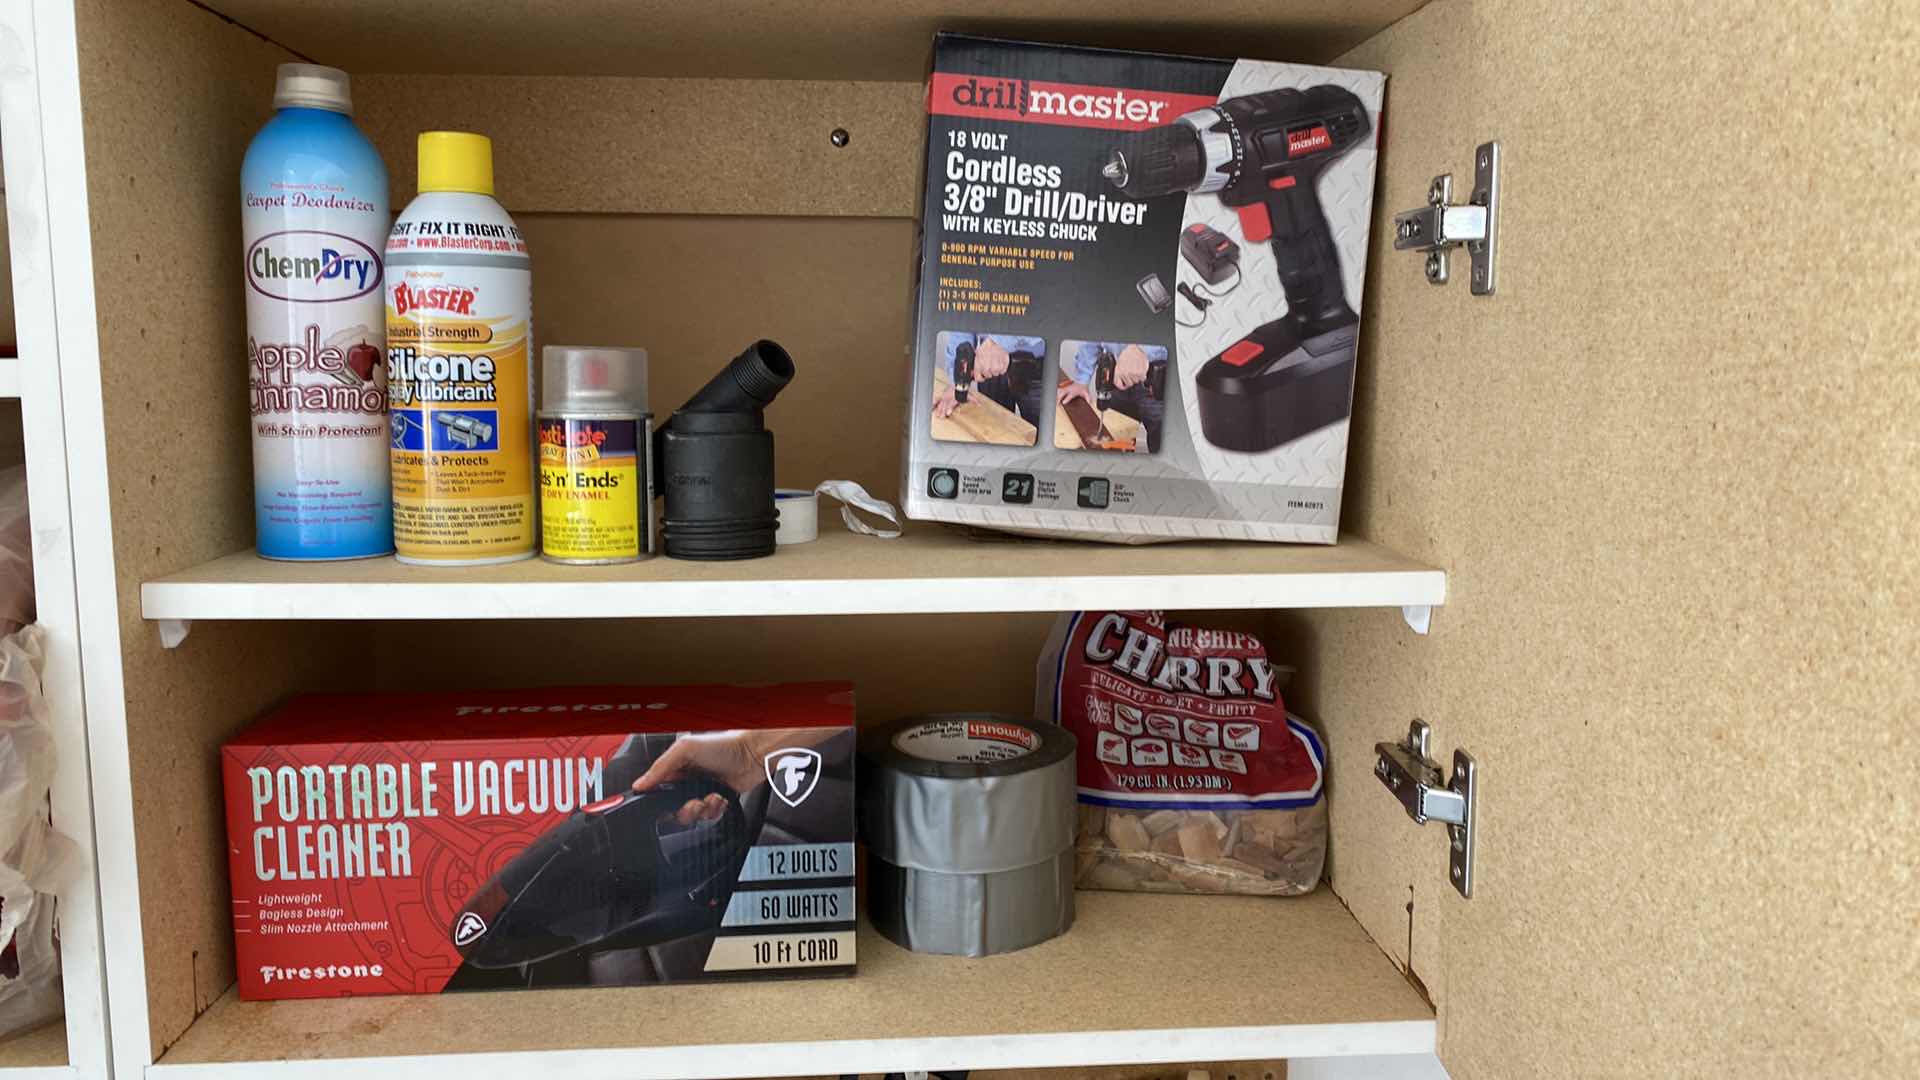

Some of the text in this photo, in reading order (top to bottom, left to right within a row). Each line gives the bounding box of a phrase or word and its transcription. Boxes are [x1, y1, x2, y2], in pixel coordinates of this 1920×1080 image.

[948, 130, 1008, 151] 18 VOLT
[946, 151, 1062, 188] Cordless
[247, 191, 375, 212] Carpet Deodorizer
[943, 184, 1148, 225] 3/8" Drill/Driver
[420, 222, 442, 234] FIX
[447, 222, 462, 234] IT
[464, 223, 506, 238] RIGHT
[942, 214, 1098, 242] WITH KEYLESS CHUCK
[417, 235, 511, 252] www.BlasterCorp.com
[967, 243, 986, 254] RPM
[988, 245, 1028, 258] VARIABLE
[1030, 248, 1056, 260] SPEED
[1058, 250, 1074, 261] FOR
[252, 247, 369, 290] ChemDry
[941, 254, 1035, 270] GENERAL PURPOSE USE
[940, 277, 982, 289] INCLUDES:
[968, 292, 990, 302] HOUR
[992, 293, 1030, 305] CHARGER
[991, 304, 1026, 316] BATTERY
[428, 327, 480, 341] Strength
[249, 322, 345, 385] Apple
[387, 346, 497, 382] Silicone
[414, 381, 497, 402] Lubricant
[258, 424, 383, 438] With Stain Protectant
[442, 456, 489, 467] Protects
[575, 471, 619, 488] Ends
[1005, 479, 1031, 497] 21
[1287, 500, 1304, 509] ITEM
[455, 702, 670, 716] Firestone
[1208, 702, 1257, 717] FRUITY
[968, 722, 1033, 747] Plymouth
[247, 757, 604, 822] PORTABLE VACUUM
[1116, 774, 1135, 788] 179
[1137, 775, 1154, 789] CU.
[252, 822, 412, 882] CLEANER
[767, 848, 838, 875] 12 VOLTS
[258, 892, 323, 906] Lightweight
[760, 894, 838, 920] 60 WATTS
[259, 907, 344, 922] Bagless Design
[260, 920, 388, 934] Slim Nozzle Attachment
[753, 938, 838, 964] 10 Ft CORD
[260, 963, 383, 985] Firestone
